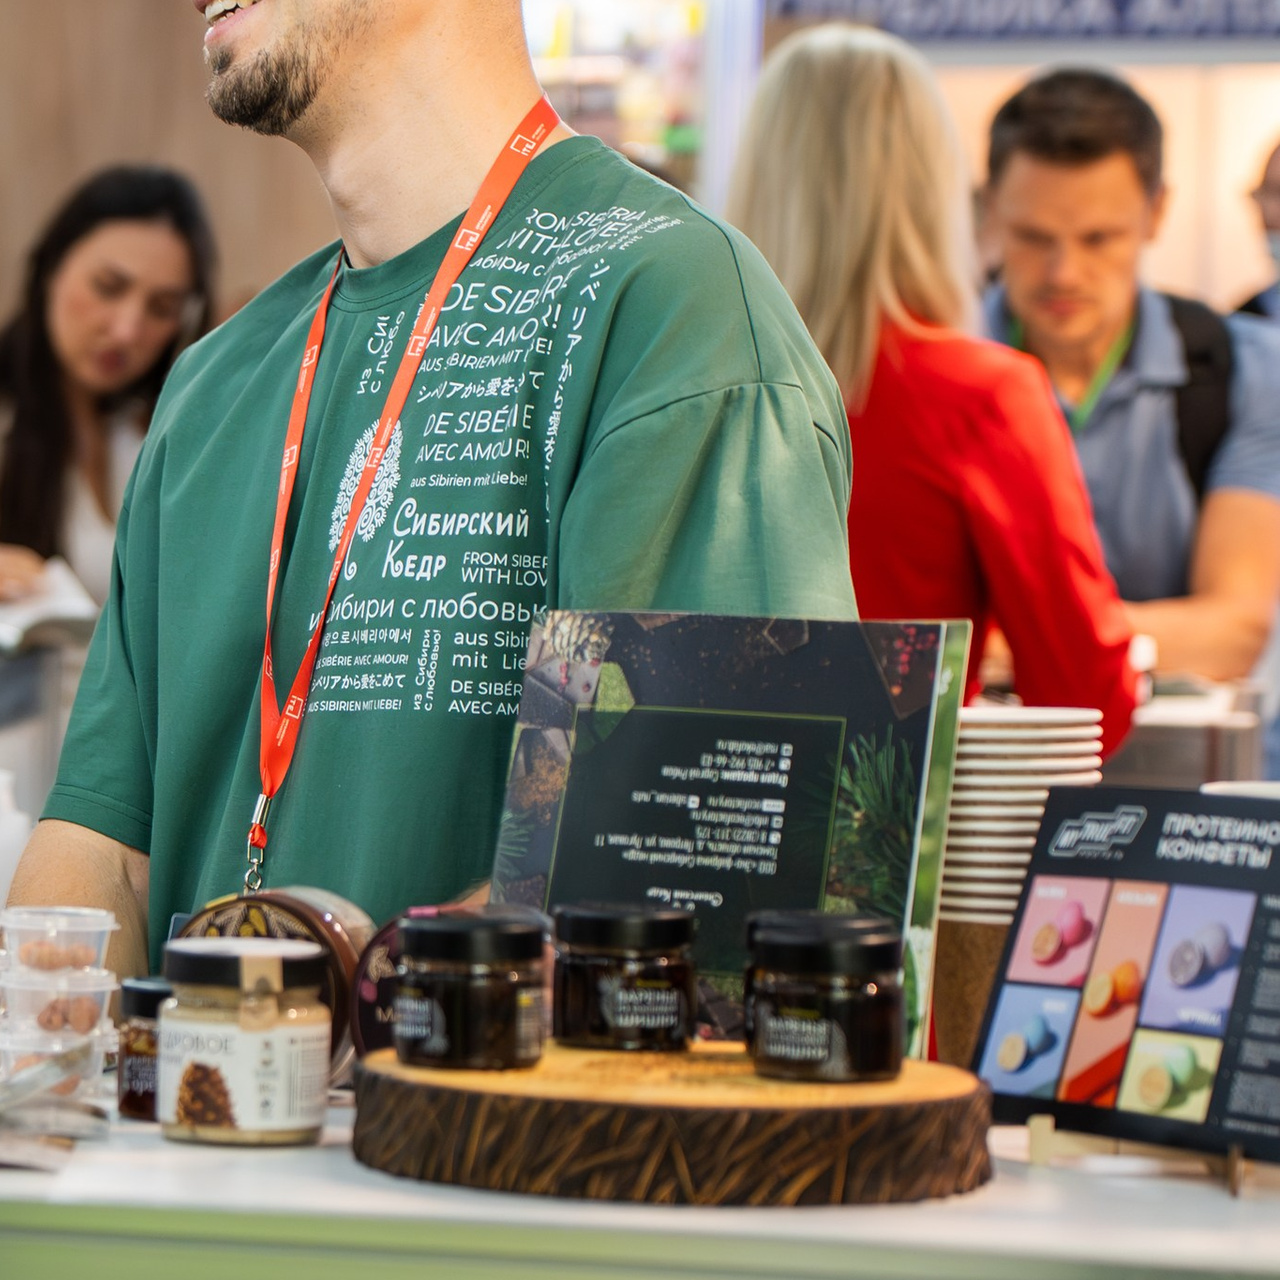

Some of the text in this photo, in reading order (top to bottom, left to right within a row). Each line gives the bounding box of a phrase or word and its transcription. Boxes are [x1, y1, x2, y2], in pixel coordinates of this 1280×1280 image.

[440, 282, 486, 312] DE
[418, 348, 524, 374] AUS MIT
[423, 411, 454, 438] DE
[415, 437, 530, 465] AVEC AMOUR!
[410, 470, 529, 489] aus Sibirien mit Liebe!
[463, 550, 508, 567] FROM
[461, 566, 512, 586] WITH
[401, 598, 417, 619] с
[453, 630, 489, 648] aus
[321, 654, 353, 669] SIBÉRIE
[353, 655, 372, 667] AVEC
[372, 653, 410, 666] AMOUR!
[415, 629, 432, 687] Сибири
[425, 628, 442, 701] любовью!
[452, 650, 488, 669] mit
[450, 679, 473, 695] DE
[320, 699, 361, 713] SIBIRIEN
[373, 698, 403, 711] LIEBE!
[448, 698, 519, 716] AVEC AM
